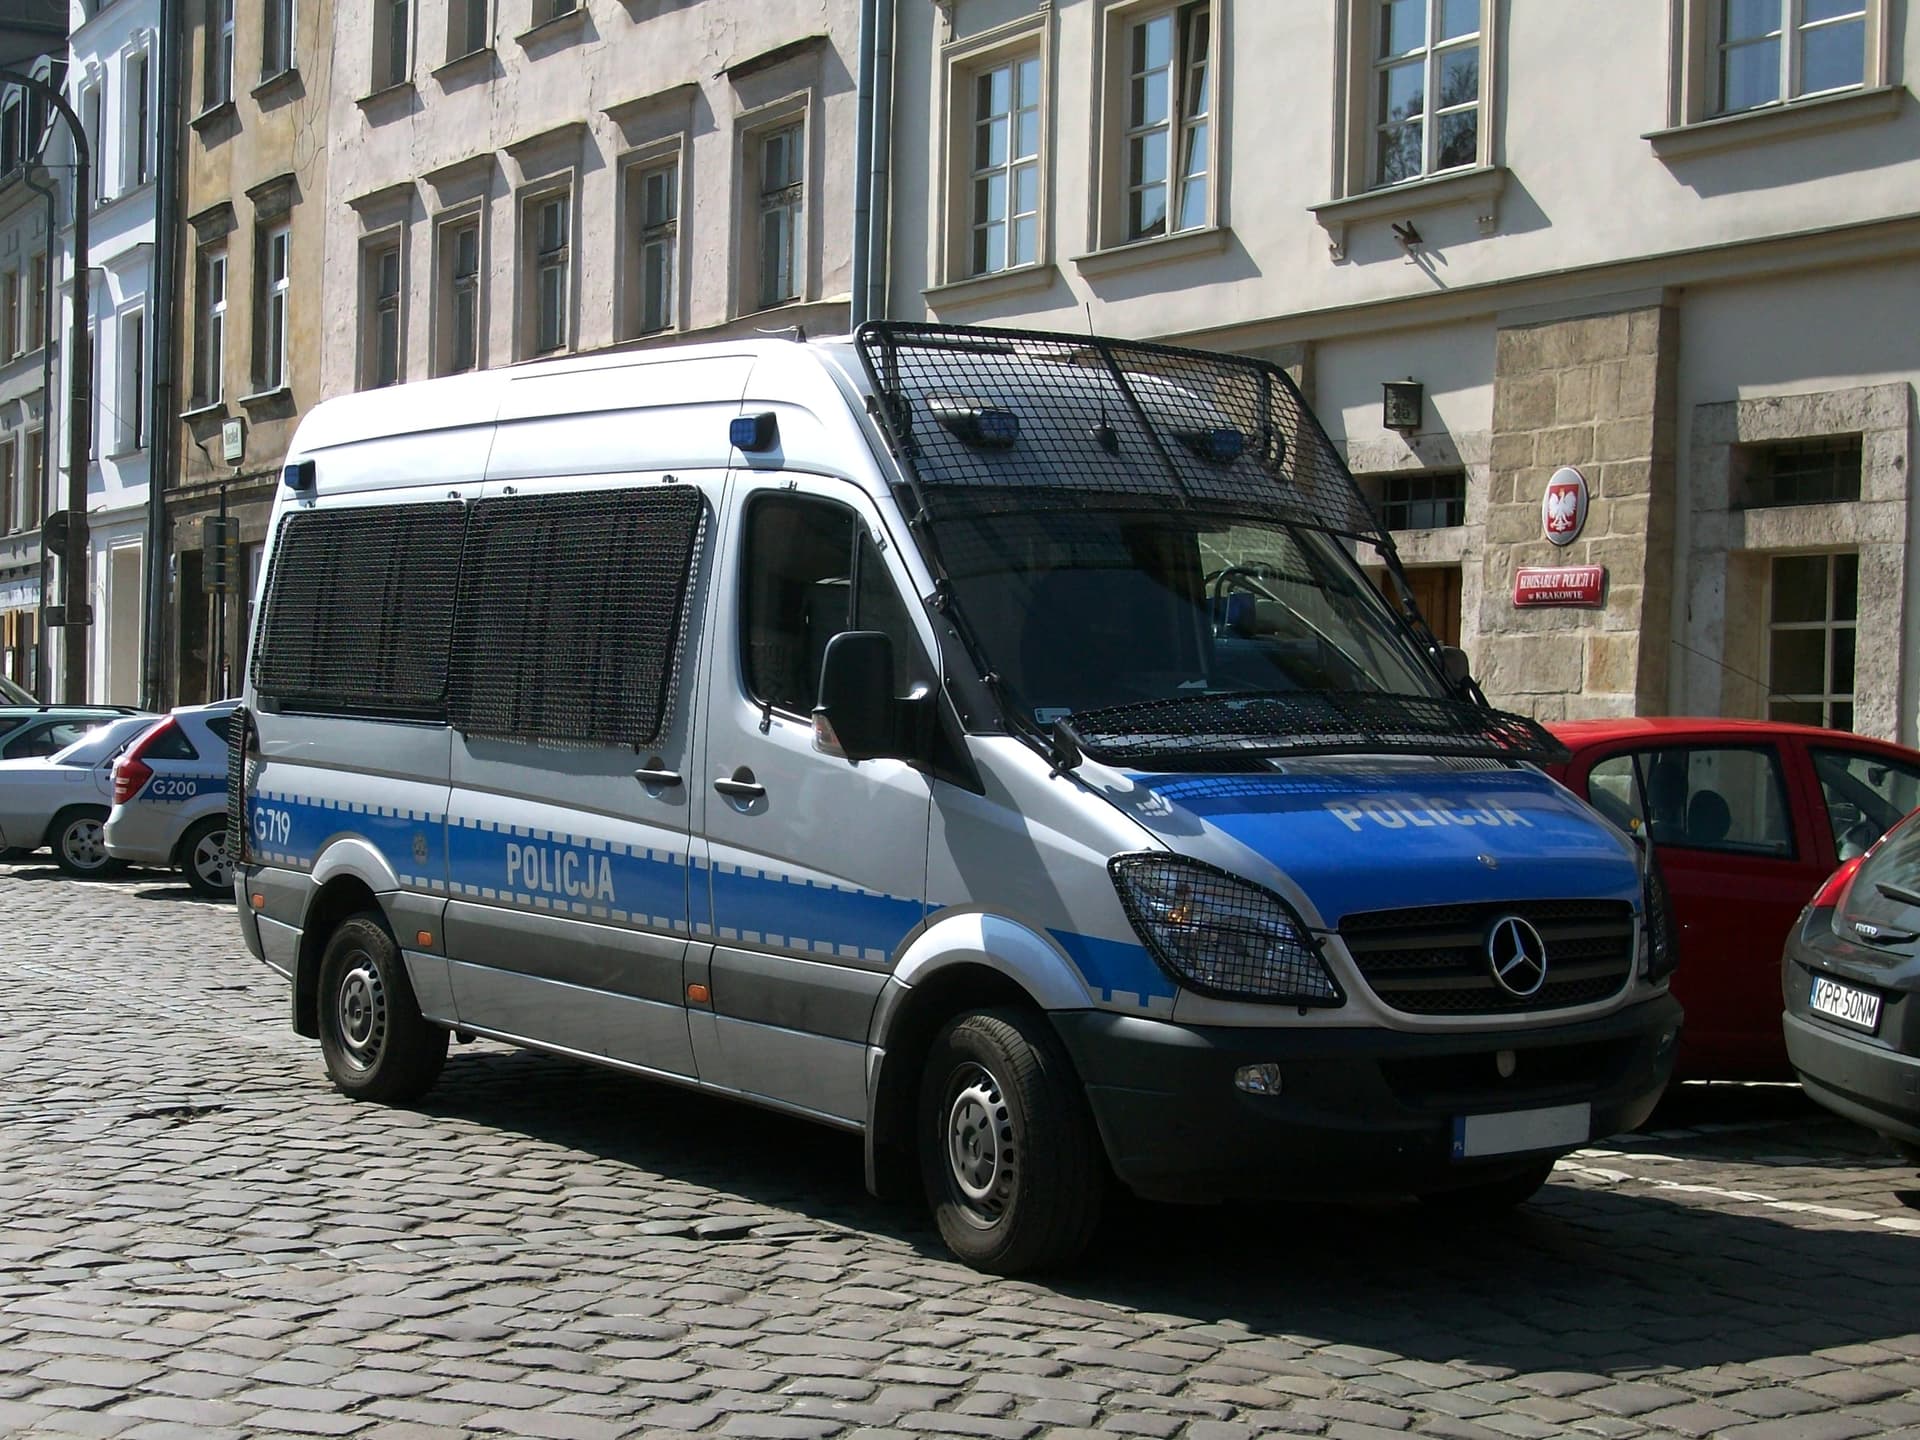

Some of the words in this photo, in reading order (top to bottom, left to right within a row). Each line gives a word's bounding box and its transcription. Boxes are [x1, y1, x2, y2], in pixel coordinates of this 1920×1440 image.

[1535, 590, 1584, 601] KRAKOWIE
[152, 780, 197, 796] G200
[253, 807, 291, 846] G719
[1321, 797, 1534, 832] POLICJA
[506, 843, 616, 903] POLICJA
[1815, 980, 1842, 1014] KPR
